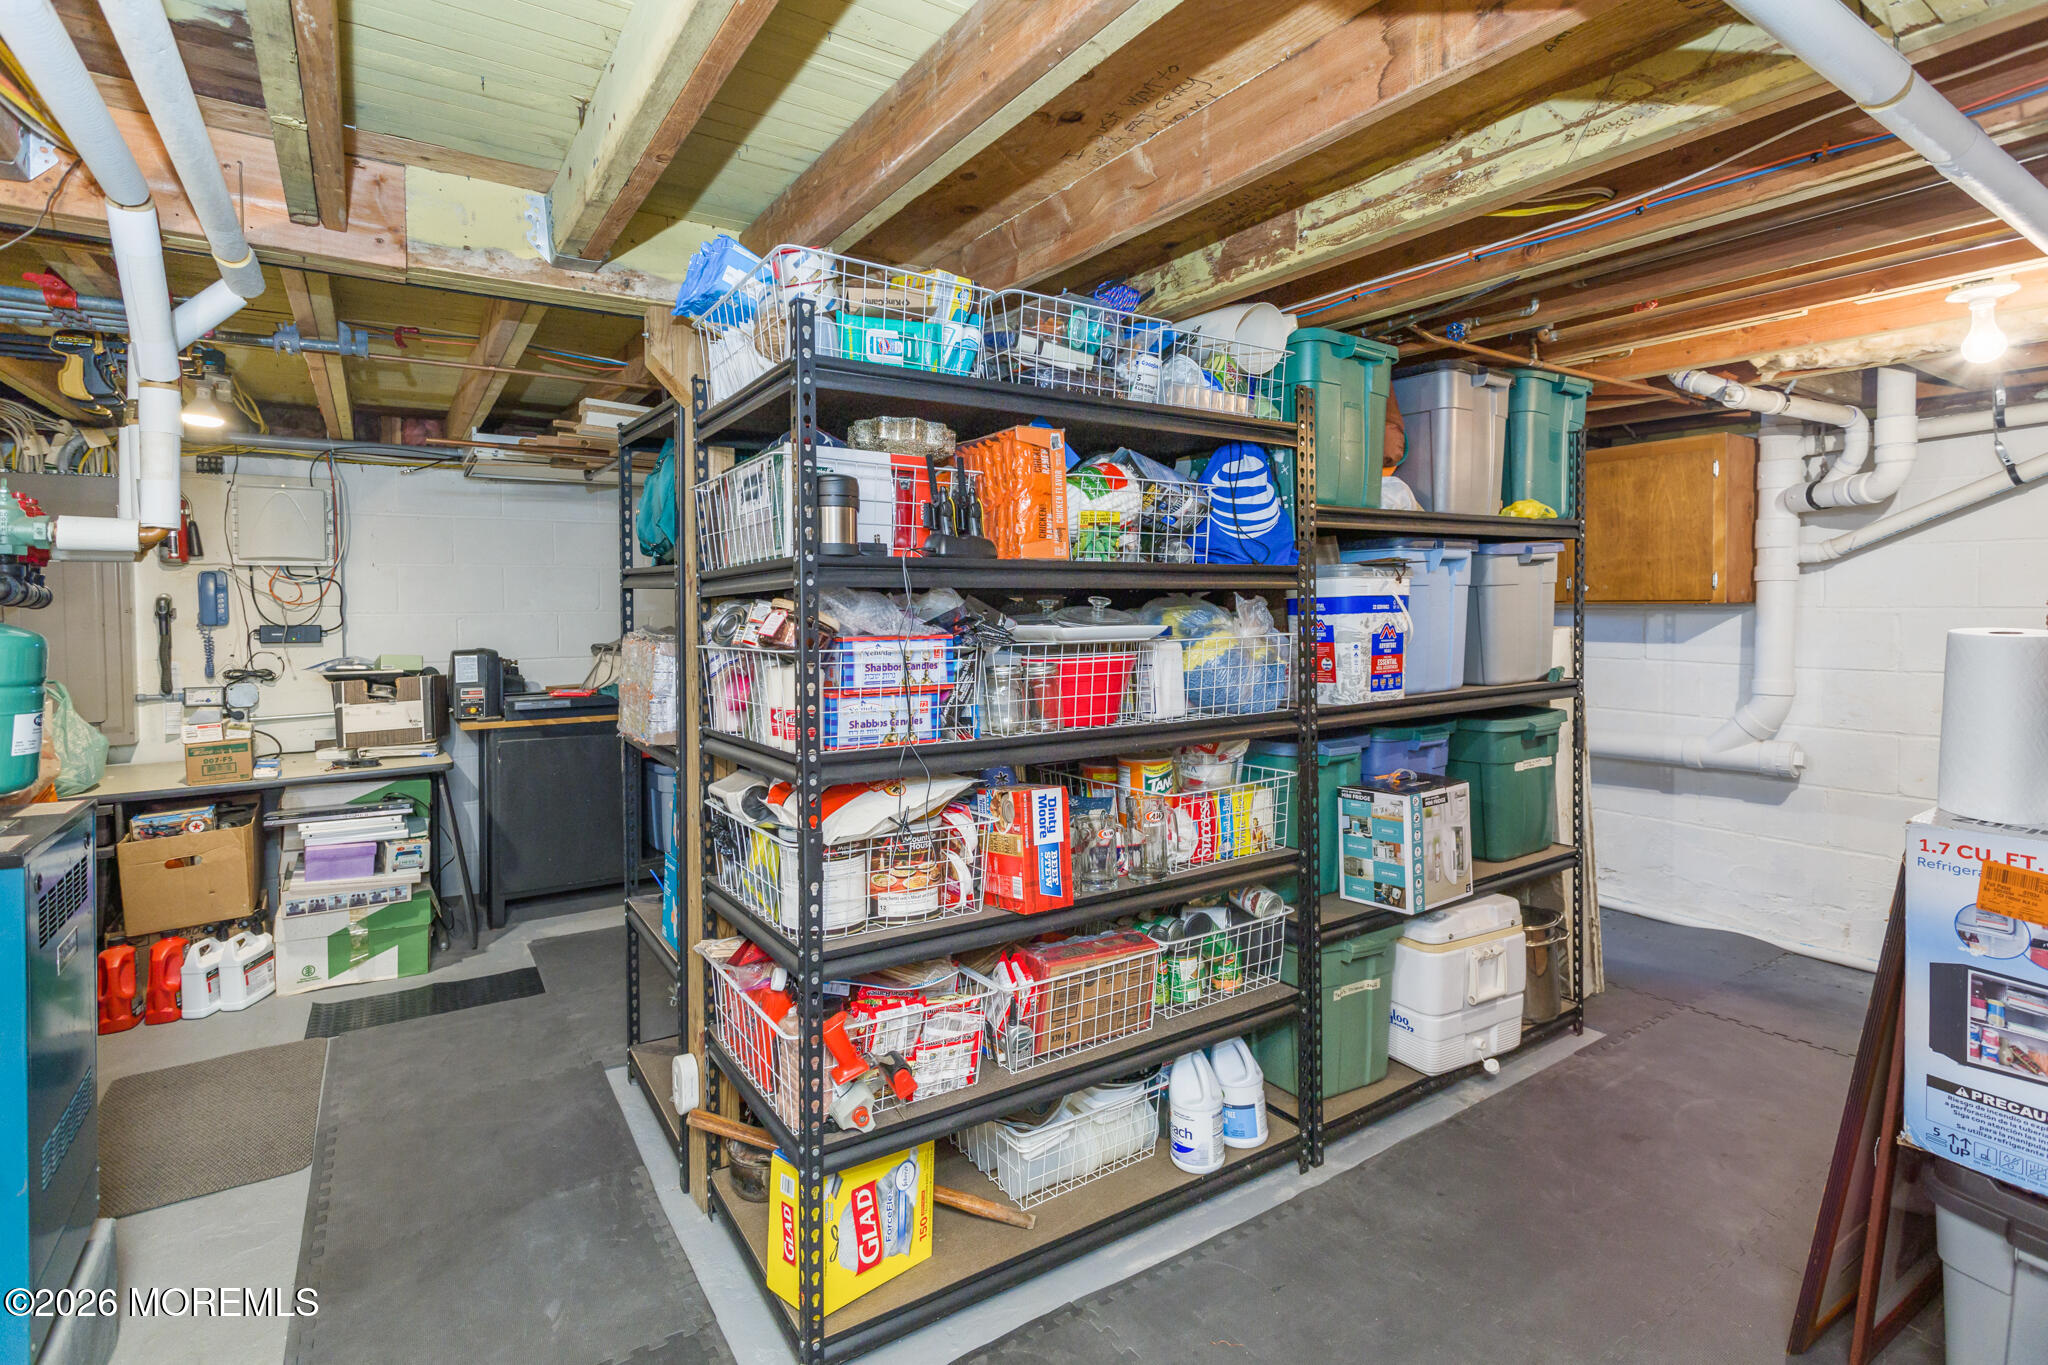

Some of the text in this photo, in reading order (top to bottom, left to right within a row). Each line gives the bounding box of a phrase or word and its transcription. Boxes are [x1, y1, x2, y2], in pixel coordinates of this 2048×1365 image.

[1054, 469, 1063, 494] FLAVOR
[1038, 507, 1047, 539] CHICKEN
[1055, 495, 1064, 524] CHICKEN
[864, 661, 939, 673] Shabbos Candles
[848, 718, 888, 729] Shabbos
[1352, 793, 1371, 802] FRIDGE
[1037, 793, 1048, 840] Moore
[1046, 796, 1057, 834] Dinty
[1197, 800, 1211, 858] Success
[1919, 838, 1950, 855] 1.7
[1044, 851, 1053, 889] STEW
[1050, 849, 1060, 886] BEEF
[1947, 1095, 1974, 1108] Riesgo
[1975, 1103, 1986, 1111] de
[1987, 1107, 2022, 1123] incendio
[1950, 1103, 1997, 1122] perforación
[1998, 1118, 2008, 1126] de
[2009, 1121, 2017, 1129] la
[1953, 1109, 1970, 1120] Siga
[1971, 1116, 1986, 1124] con
[1987, 1121, 2025, 1136] atención
[2026, 1132, 2037, 1141] las
[1979, 1125, 1998, 1136] para
[1999, 1130, 2006, 1138] la
[1949, 1144, 1971, 1157] UP
[1956, 1123, 2044, 1158] Se utiliza refrigerante
[783, 1205, 795, 1262] GLAD
[858, 1187, 880, 1265] GLAD
[919, 1216, 928, 1243] 150
